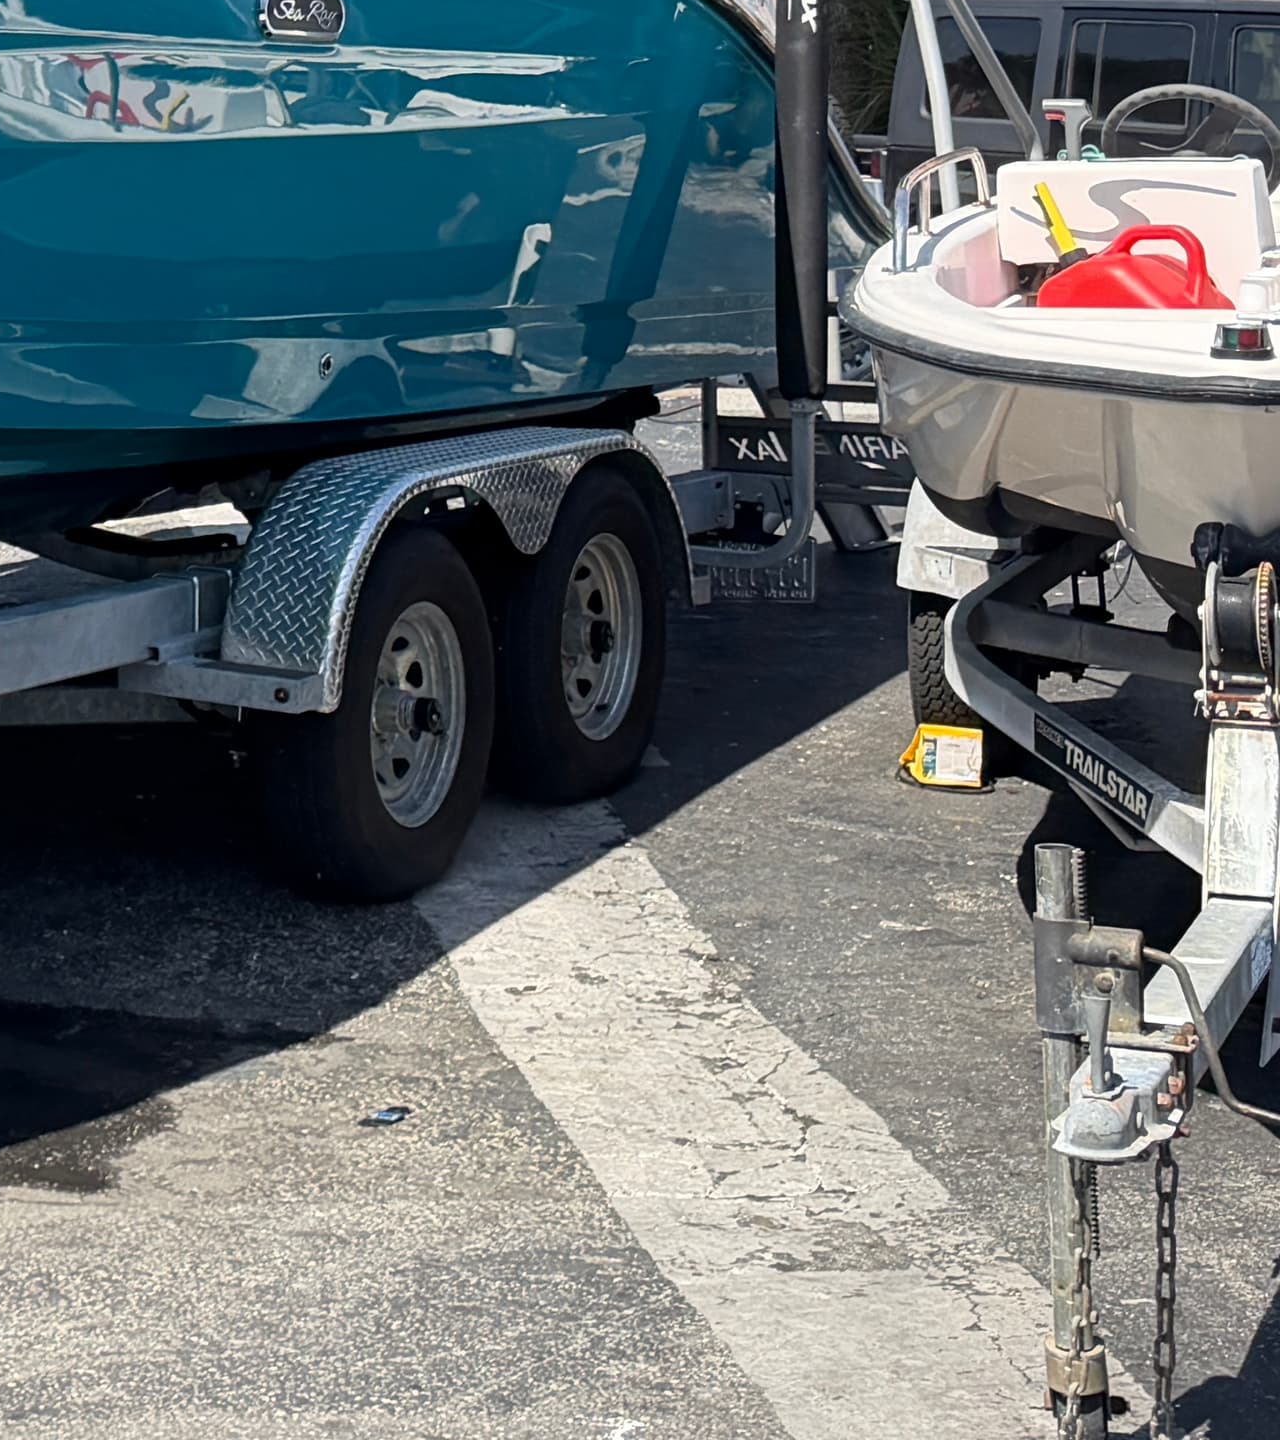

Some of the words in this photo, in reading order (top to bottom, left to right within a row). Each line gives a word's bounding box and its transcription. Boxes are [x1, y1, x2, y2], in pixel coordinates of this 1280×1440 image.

[273, 0, 305, 21] Sea
[306, 0, 339, 30] Ray
[1064, 739, 1147, 820] TRAILSTAR
